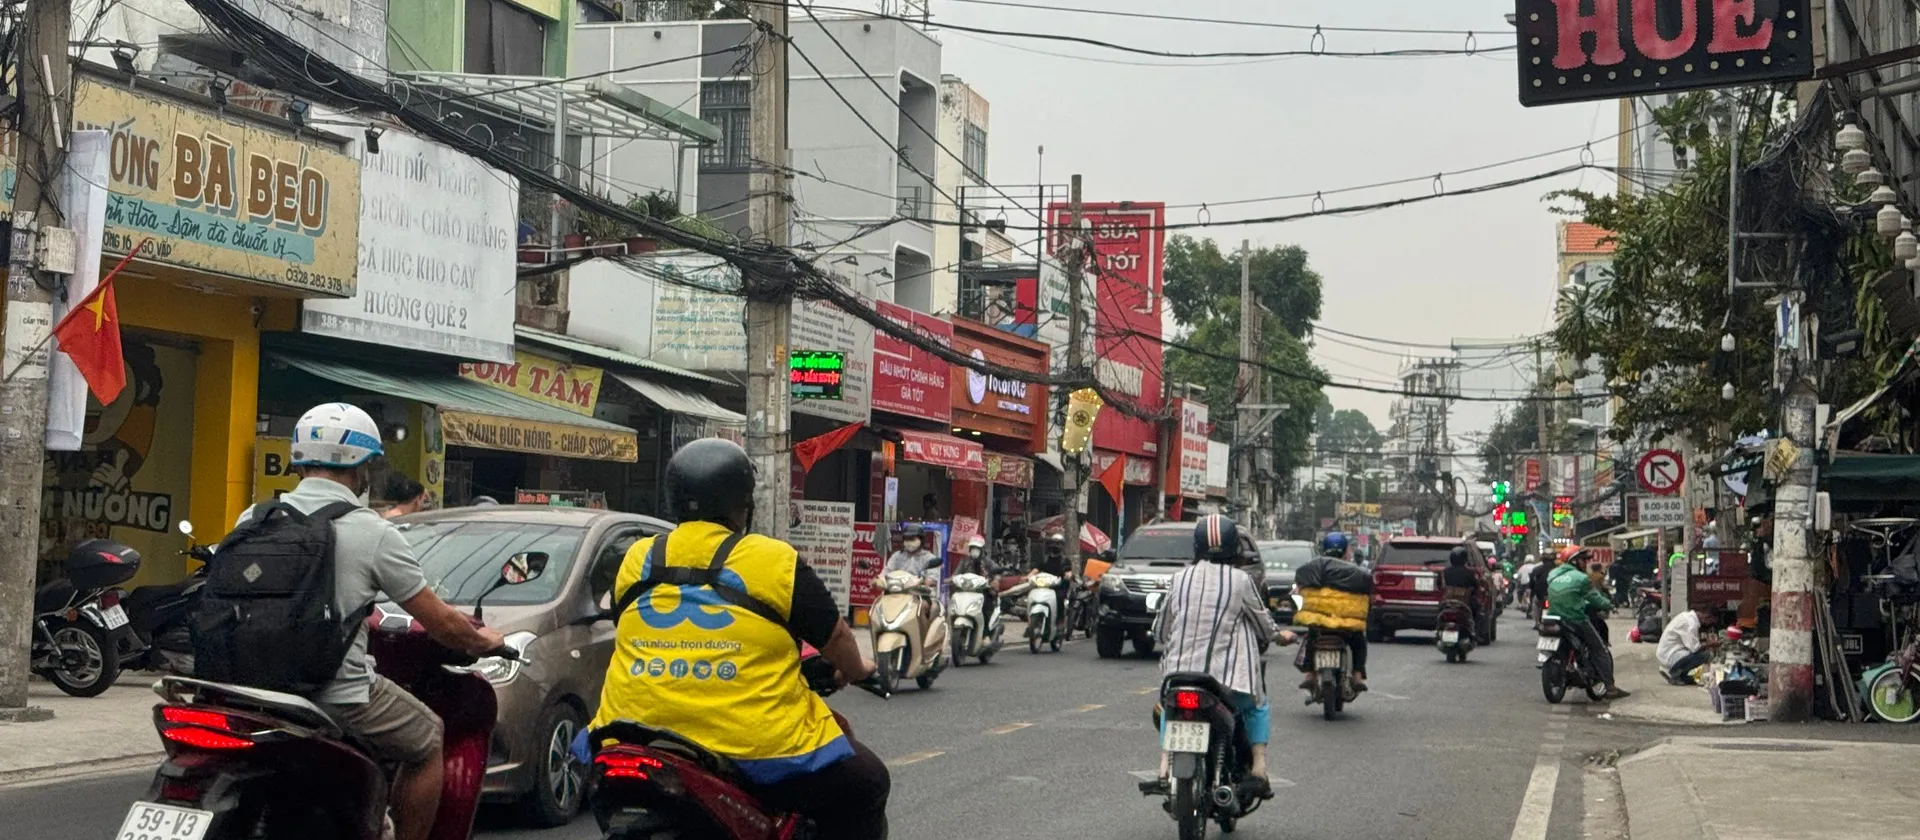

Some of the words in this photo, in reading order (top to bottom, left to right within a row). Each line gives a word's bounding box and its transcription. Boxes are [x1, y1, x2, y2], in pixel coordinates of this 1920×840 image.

[173, 130, 236, 210] BÀ
[247, 144, 326, 232] BÉO
[127, 201, 159, 230] Hòa
[167, 209, 203, 241] Đậm
[207, 217, 228, 245] đà
[231, 223, 269, 252] chuẩn
[1098, 218, 1139, 240] SỮA
[122, 234, 132, 250] 16
[416, 255, 447, 284] KHO
[450, 262, 477, 290] CAY
[1105, 247, 1142, 271] TỐT
[285, 267, 310, 287] 0328
[309, 273, 326, 290] 282
[363, 289, 421, 322] HƯƠNG
[459, 307, 468, 329] 2
[528, 362, 594, 408] TẤM
[912, 386, 924, 403] TỐT
[466, 419, 497, 445] BÁNH
[523, 424, 551, 450] NÓNG
[560, 431, 586, 454] CHÁO
[649, 639, 677, 650] nhau
[680, 640, 703, 651] trọn
[704, 639, 742, 652] đường
[1844, 638, 1860, 650] JBL
[136, 807, 199, 837] 59-V3
